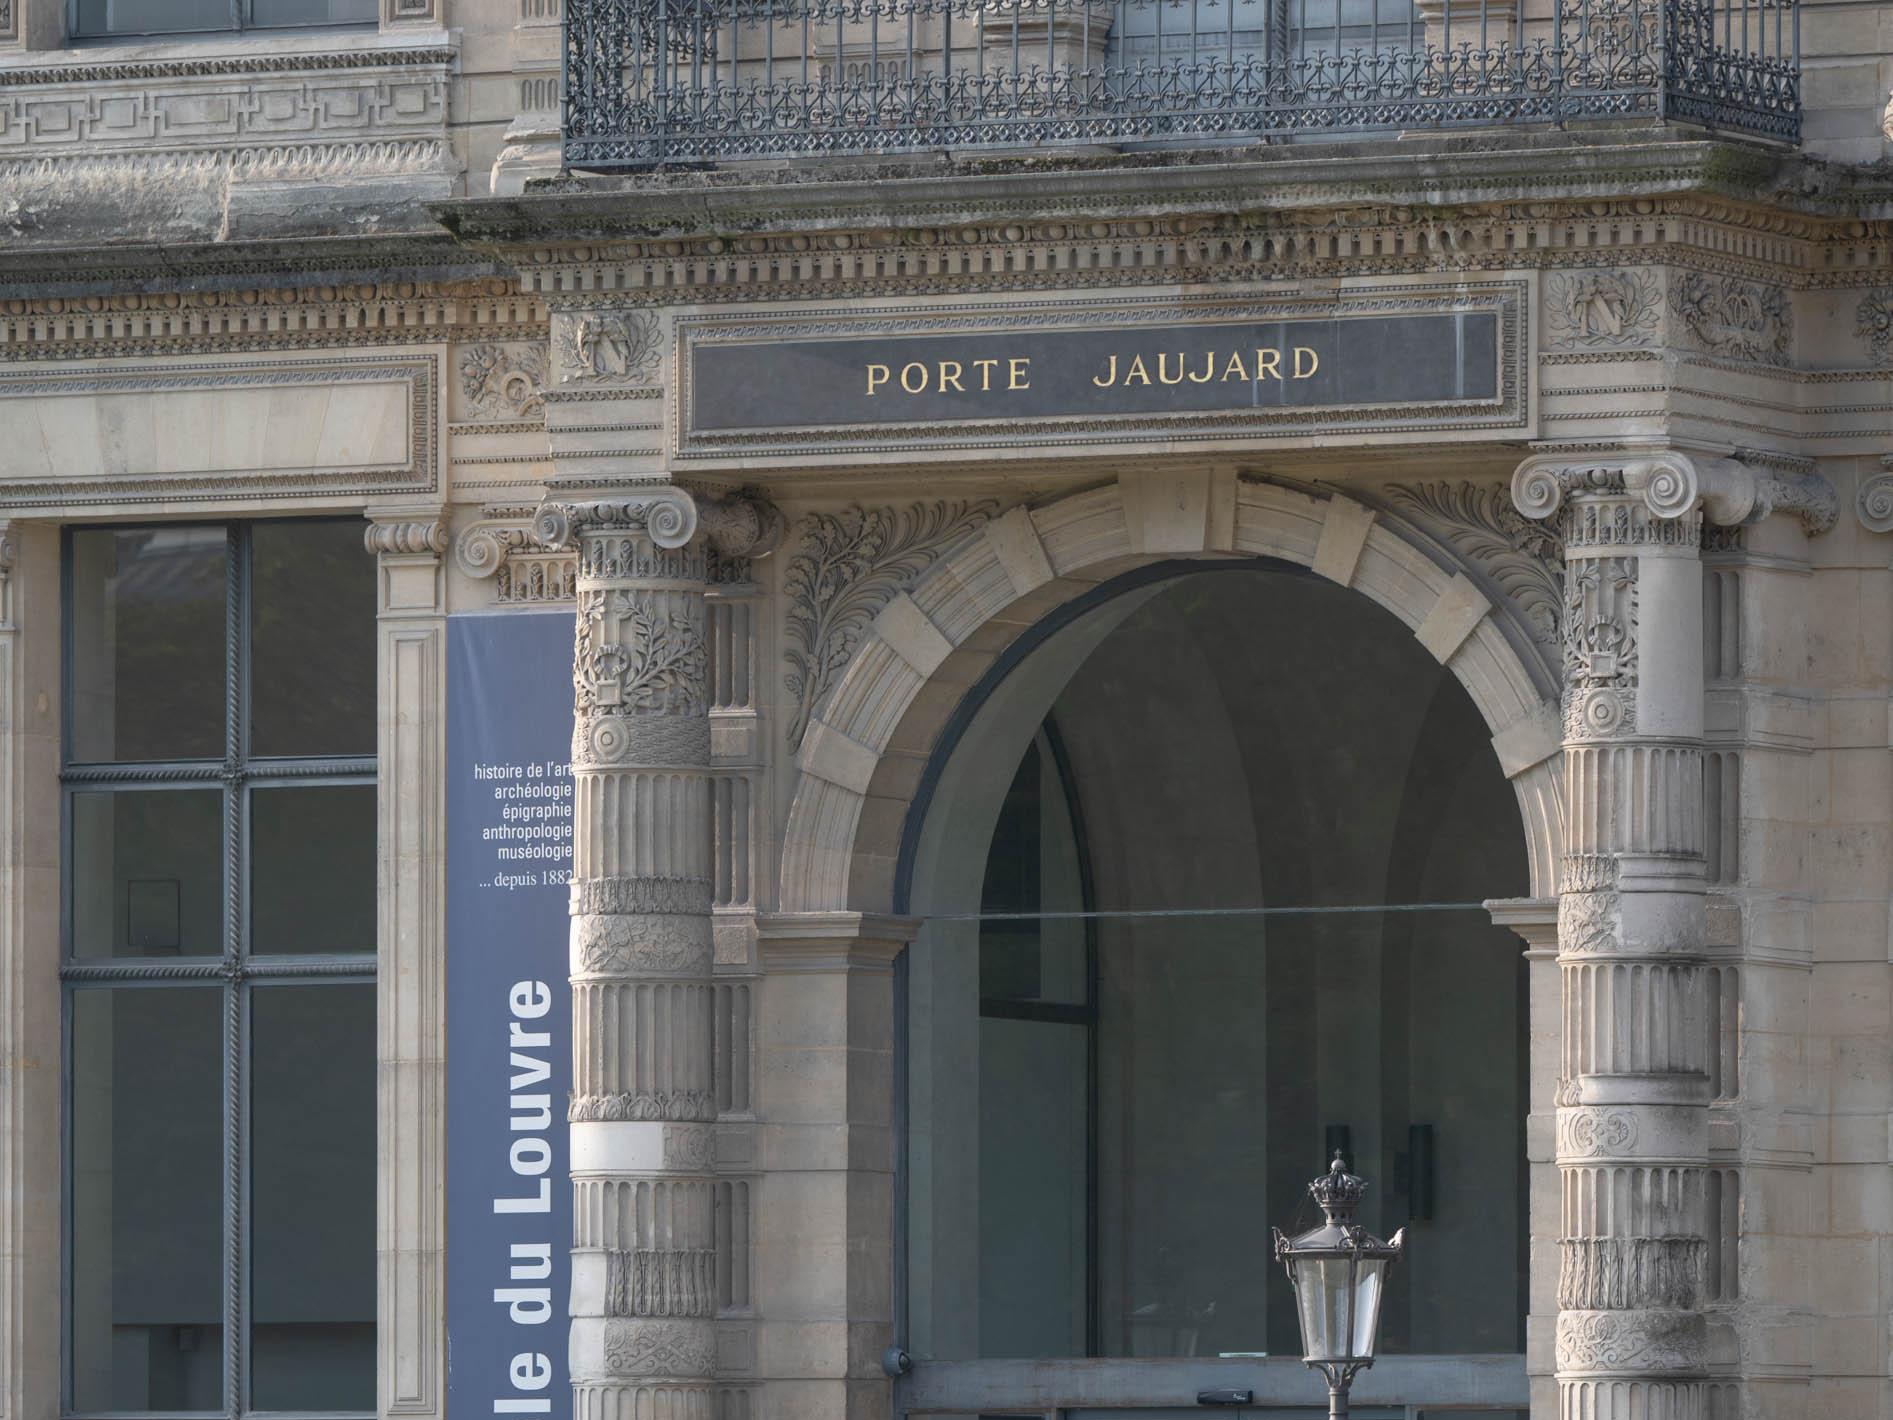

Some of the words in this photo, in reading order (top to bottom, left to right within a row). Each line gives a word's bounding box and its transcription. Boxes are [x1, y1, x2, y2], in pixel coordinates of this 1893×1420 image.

[865, 358, 1031, 395] PORTE
[1092, 347, 1319, 387] JAUJARD
[474, 763, 522, 780] histoire
[527, 762, 543, 778] de
[547, 761, 573, 777] l'art
[494, 781, 572, 800] archéologie
[502, 801, 572, 822] épigraphie
[482, 821, 573, 842] anthropologie
[498, 842, 573, 862] muséologie
[494, 871, 537, 891] depuis
[542, 869, 573, 885] 1882
[493, 980, 552, 1214] Louvre
[493, 1243, 552, 1325] du
